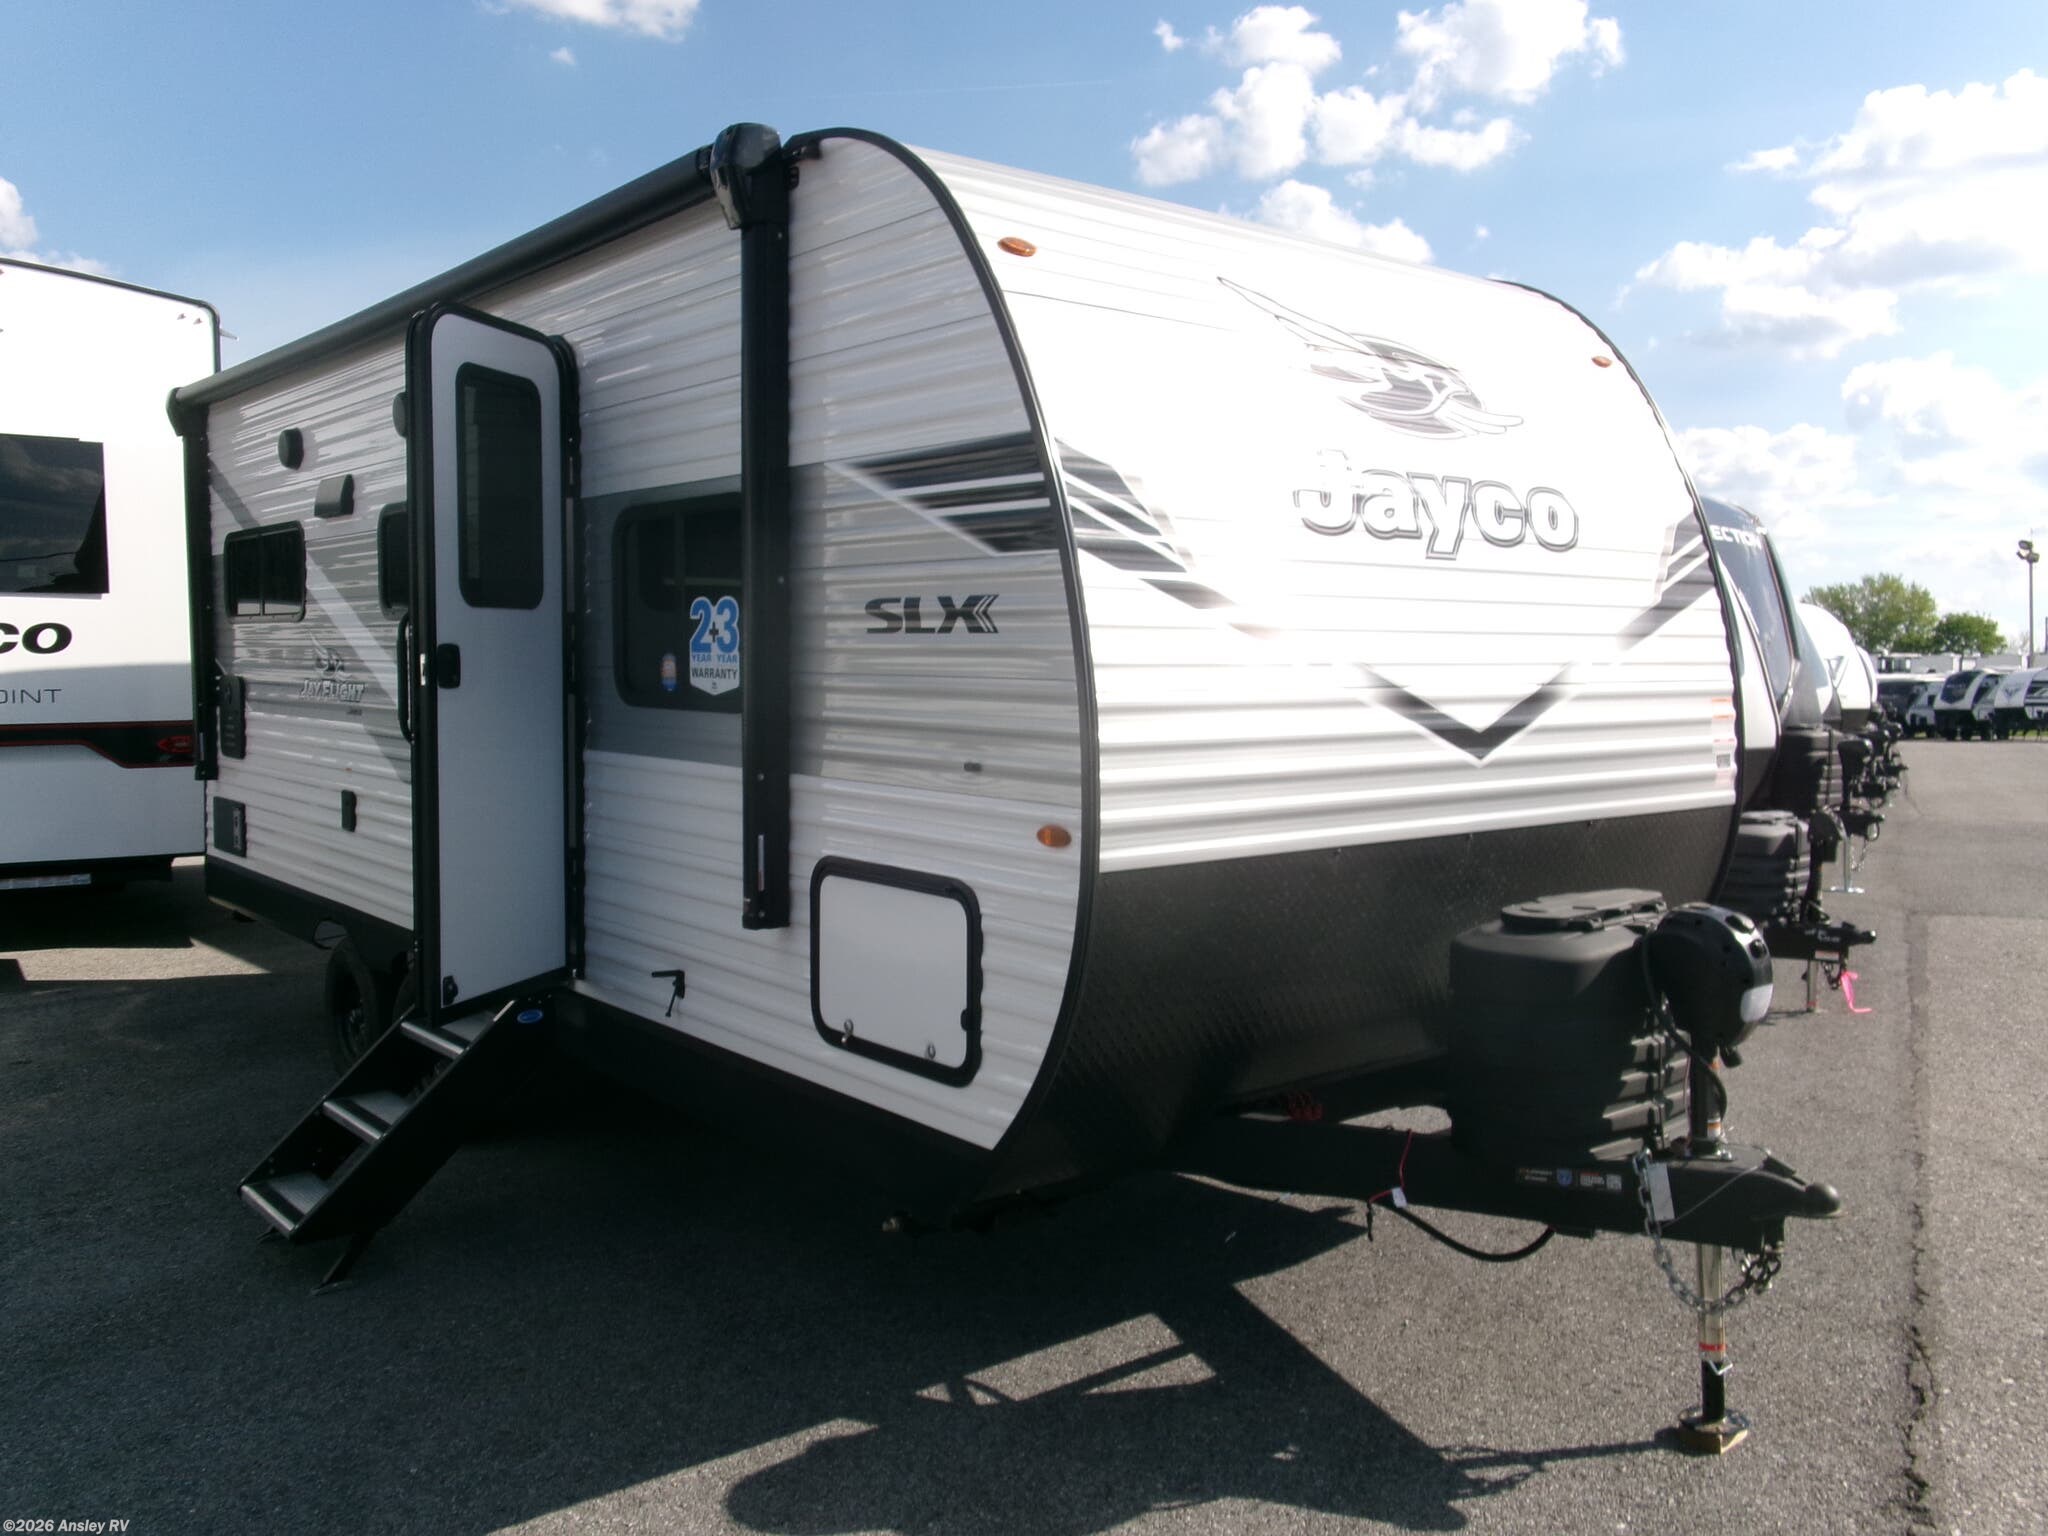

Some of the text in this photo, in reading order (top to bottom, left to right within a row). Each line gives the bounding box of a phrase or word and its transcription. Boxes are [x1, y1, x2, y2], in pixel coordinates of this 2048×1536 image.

[1293, 449, 1578, 561] Jayco
[864, 594, 999, 633] SLX
[692, 654, 738, 663] YEAR YEAR
[691, 667, 738, 680] WARRANTY
